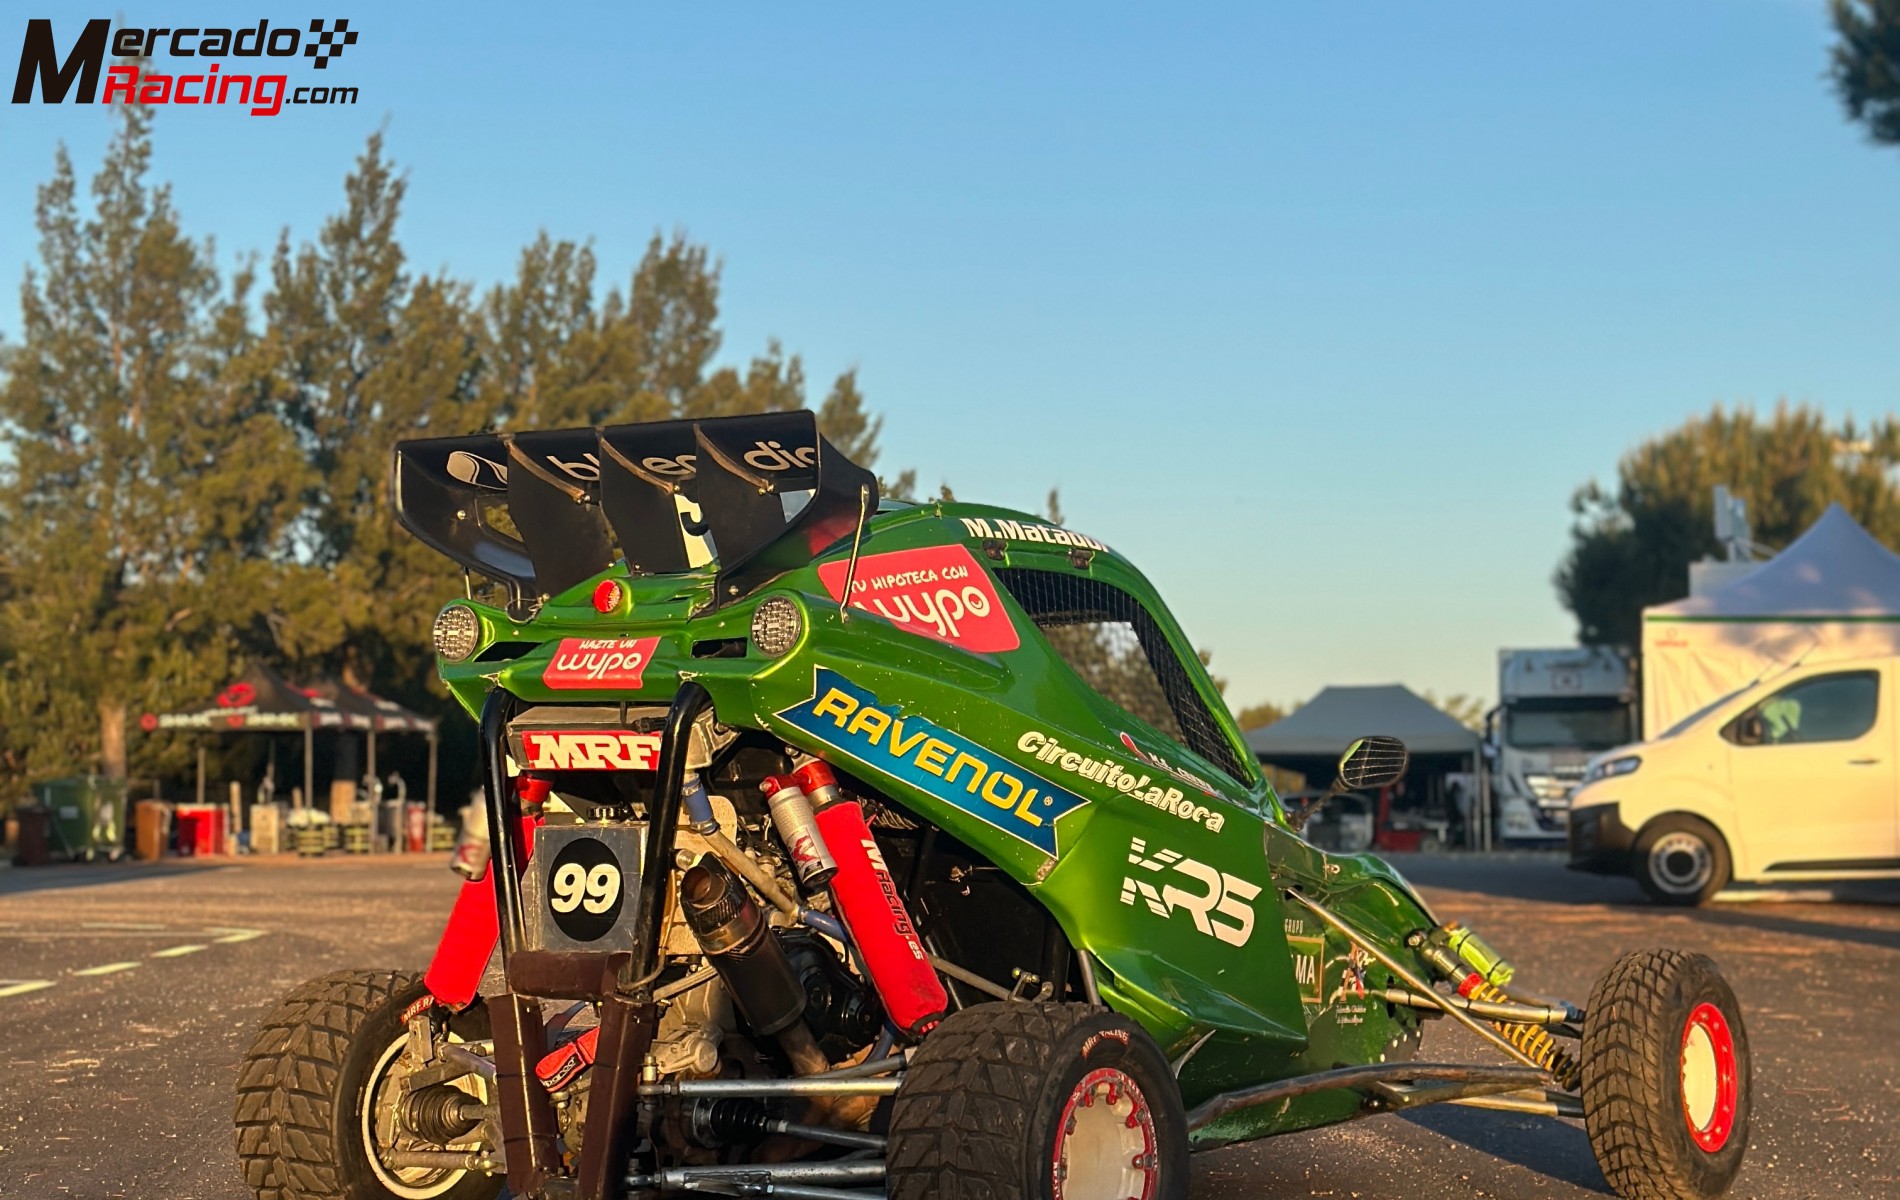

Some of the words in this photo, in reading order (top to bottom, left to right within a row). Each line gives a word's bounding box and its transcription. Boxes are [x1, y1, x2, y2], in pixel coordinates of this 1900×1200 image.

[871, 569, 938, 590] HIPOTECA
[942, 565, 968, 579] CON
[557, 653, 642, 680] wypo
[531, 735, 661, 769] MRF
[812, 687, 1043, 827] RAVENOL
[551, 863, 621, 914] 99
[1120, 836, 1263, 947] KRS
[1284, 918, 1304, 934] GRUPO
[542, 1058, 576, 1088] parco
